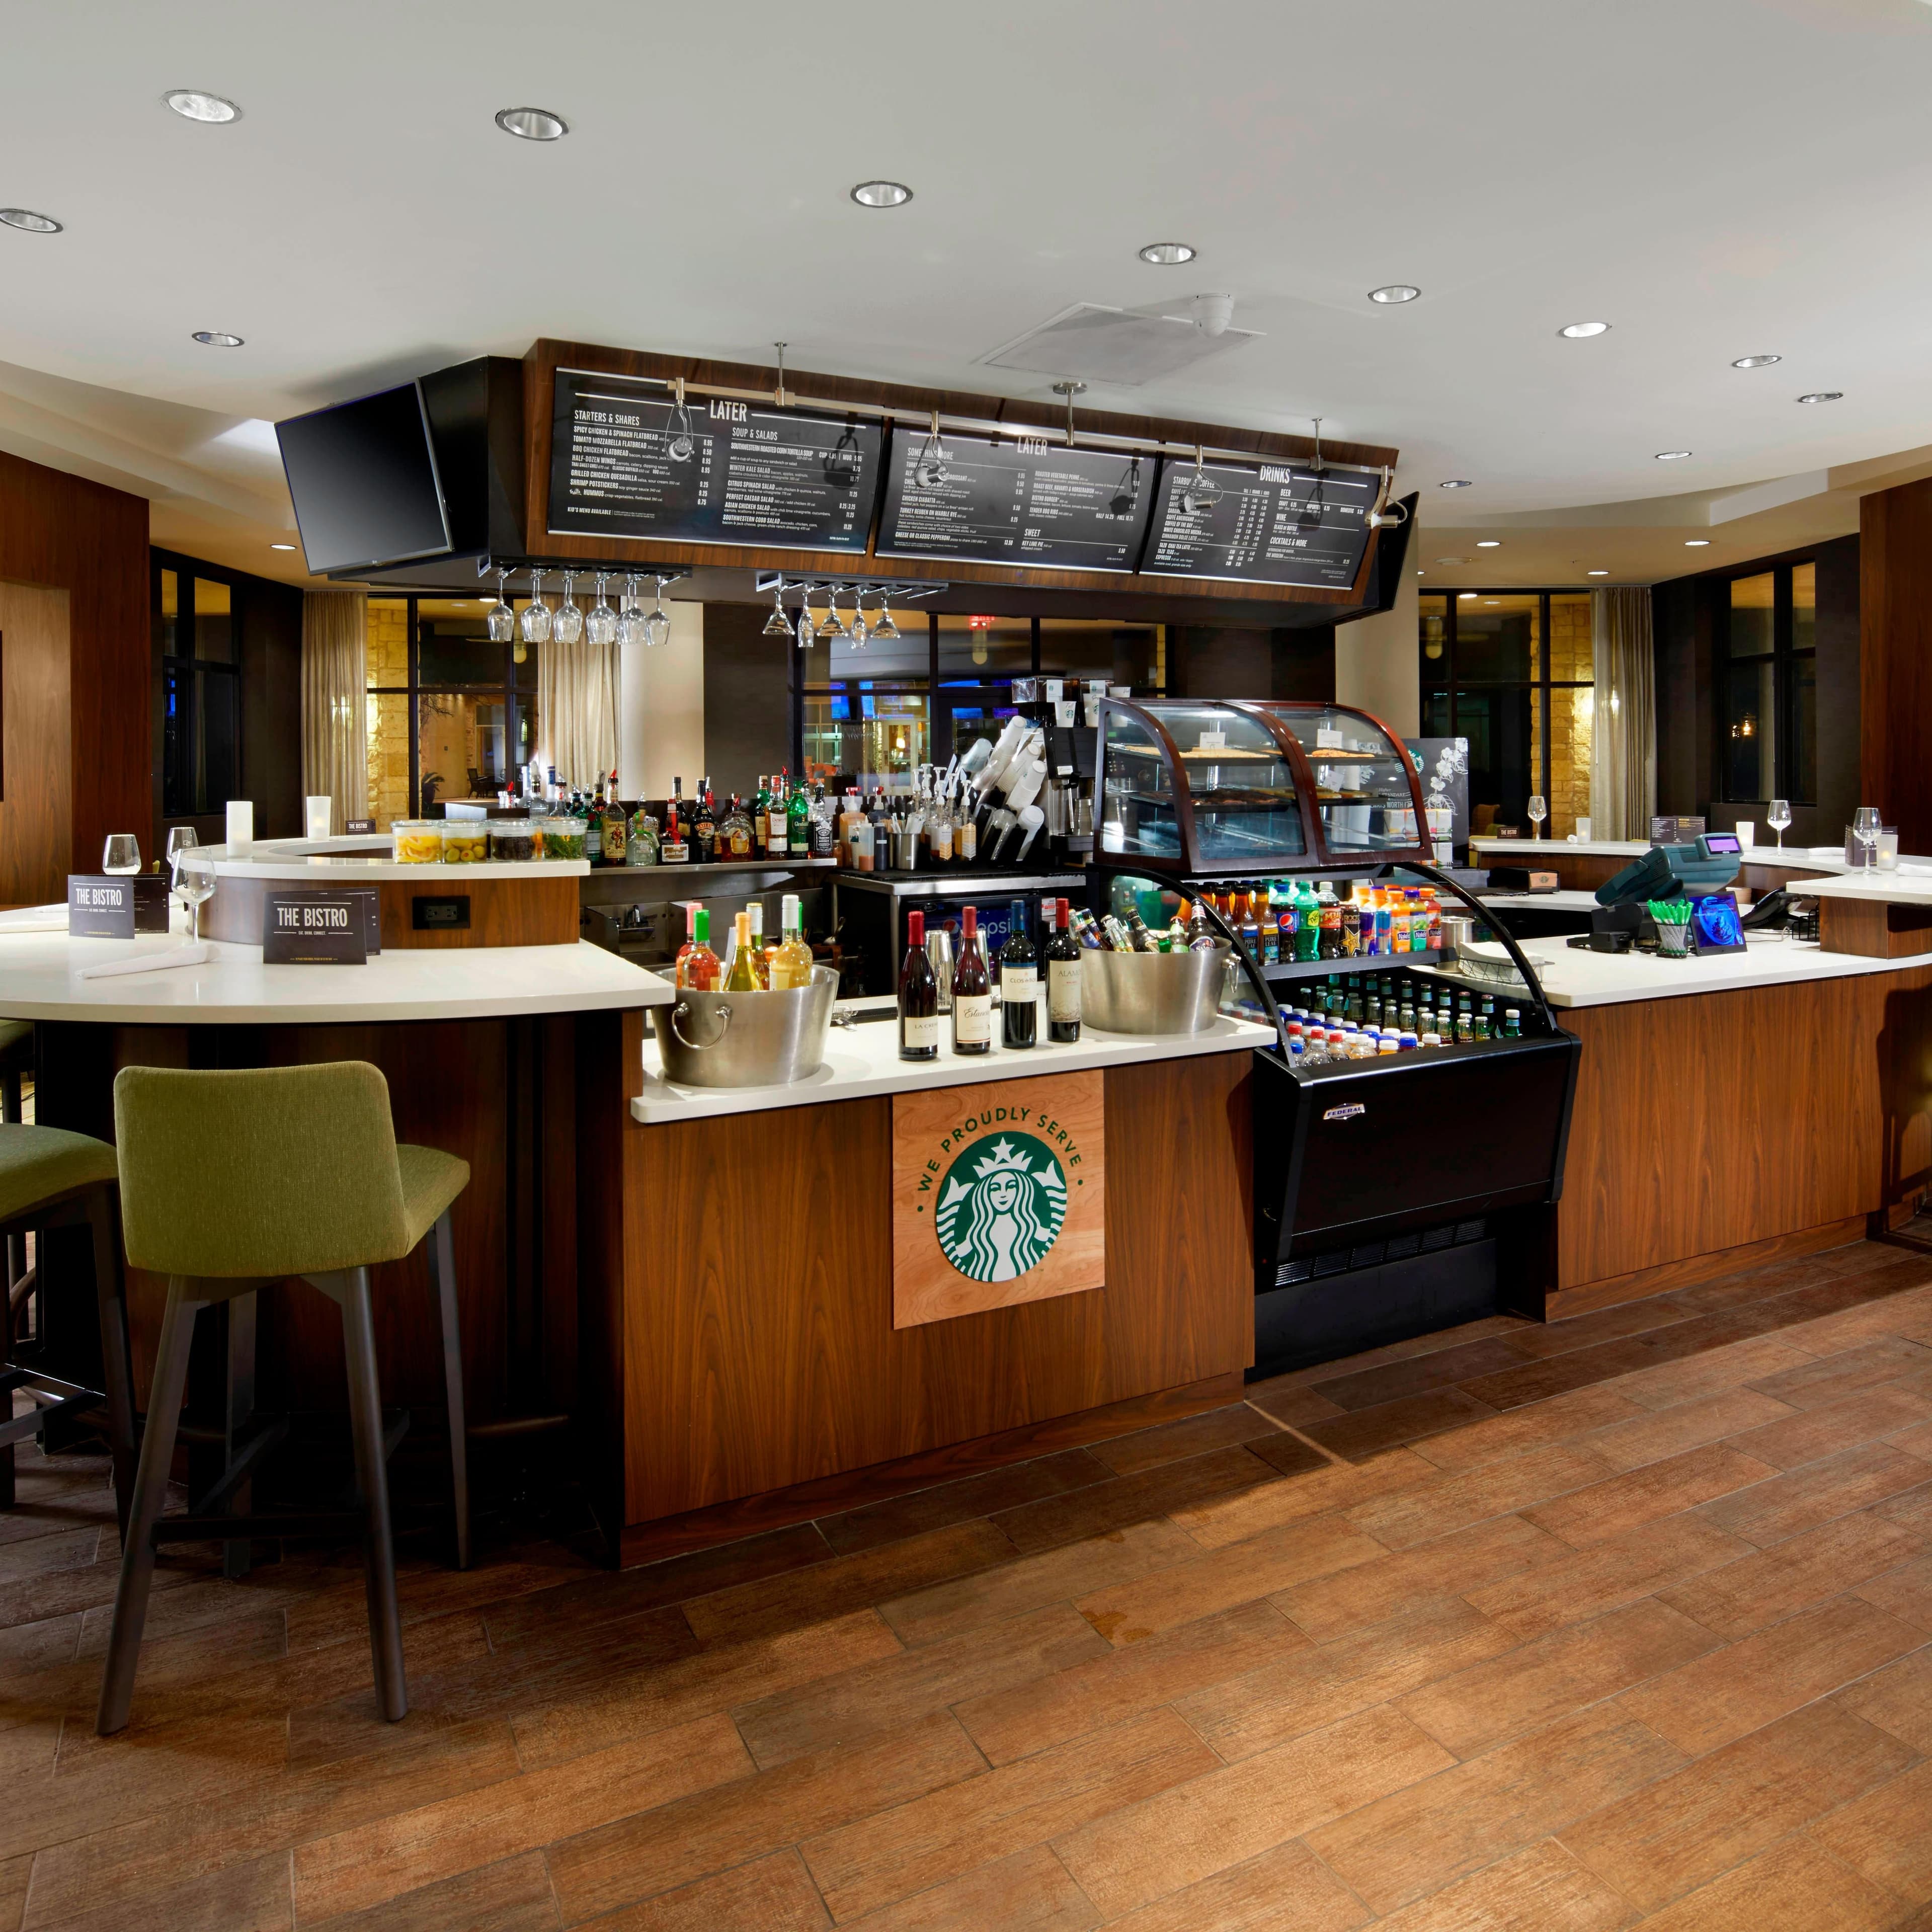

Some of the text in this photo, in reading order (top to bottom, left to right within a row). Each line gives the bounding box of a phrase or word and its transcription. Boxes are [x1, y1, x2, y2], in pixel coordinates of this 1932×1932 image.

[710, 399, 747, 422] LATER
[575, 410, 639, 426] STARTERS & SHARES
[574, 426, 587, 434] SPICY
[588, 428, 607, 436] CHICKEN
[613, 430, 632, 438] SPINACH
[634, 432, 658, 441] FLATBREAD
[733, 427, 777, 441] SOUP & SALADS
[573, 435, 591, 443] TOMATO
[593, 437, 621, 446] MOZZARELLA
[622, 440, 646, 449] FLATBREAD
[731, 442, 760, 452] SOUTHWESTERN
[761, 445, 776, 453] ROASTED
[1017, 436, 1048, 456] LATER
[573, 445, 582, 453] BBQ
[583, 446, 602, 454] CHICKEN
[604, 448, 628, 456] FLATBREAD
[572, 454, 600, 463] HALF-DOZEN
[601, 457, 615, 465] WINGS
[571, 469, 589, 477] GRILLED
[590, 471, 609, 479] CHICKEN
[610, 473, 636, 482] QUESADILLA
[1260, 465, 1291, 484] DRINKS
[570, 478, 588, 487] SHRIMP
[589, 480, 618, 489] POTSTICKERS
[584, 489, 604, 497] HUMMUS
[1280, 489, 1291, 497] BEER
[1276, 513, 1286, 521] WINE
[1024, 528, 1040, 537] SWEET
[1270, 536, 1291, 545] COCKTAILS
[1296, 539, 1307, 547] MORE
[76, 889, 122, 906] THE BISTRO
[277, 908, 300, 926] THE
[304, 908, 348, 927] BISTRO
[977, 918, 1010, 938] epsi
[1327, 1107, 1360, 1116] FEDERAL
[918, 1107, 1082, 1191] WE PROUDLY SERVE
